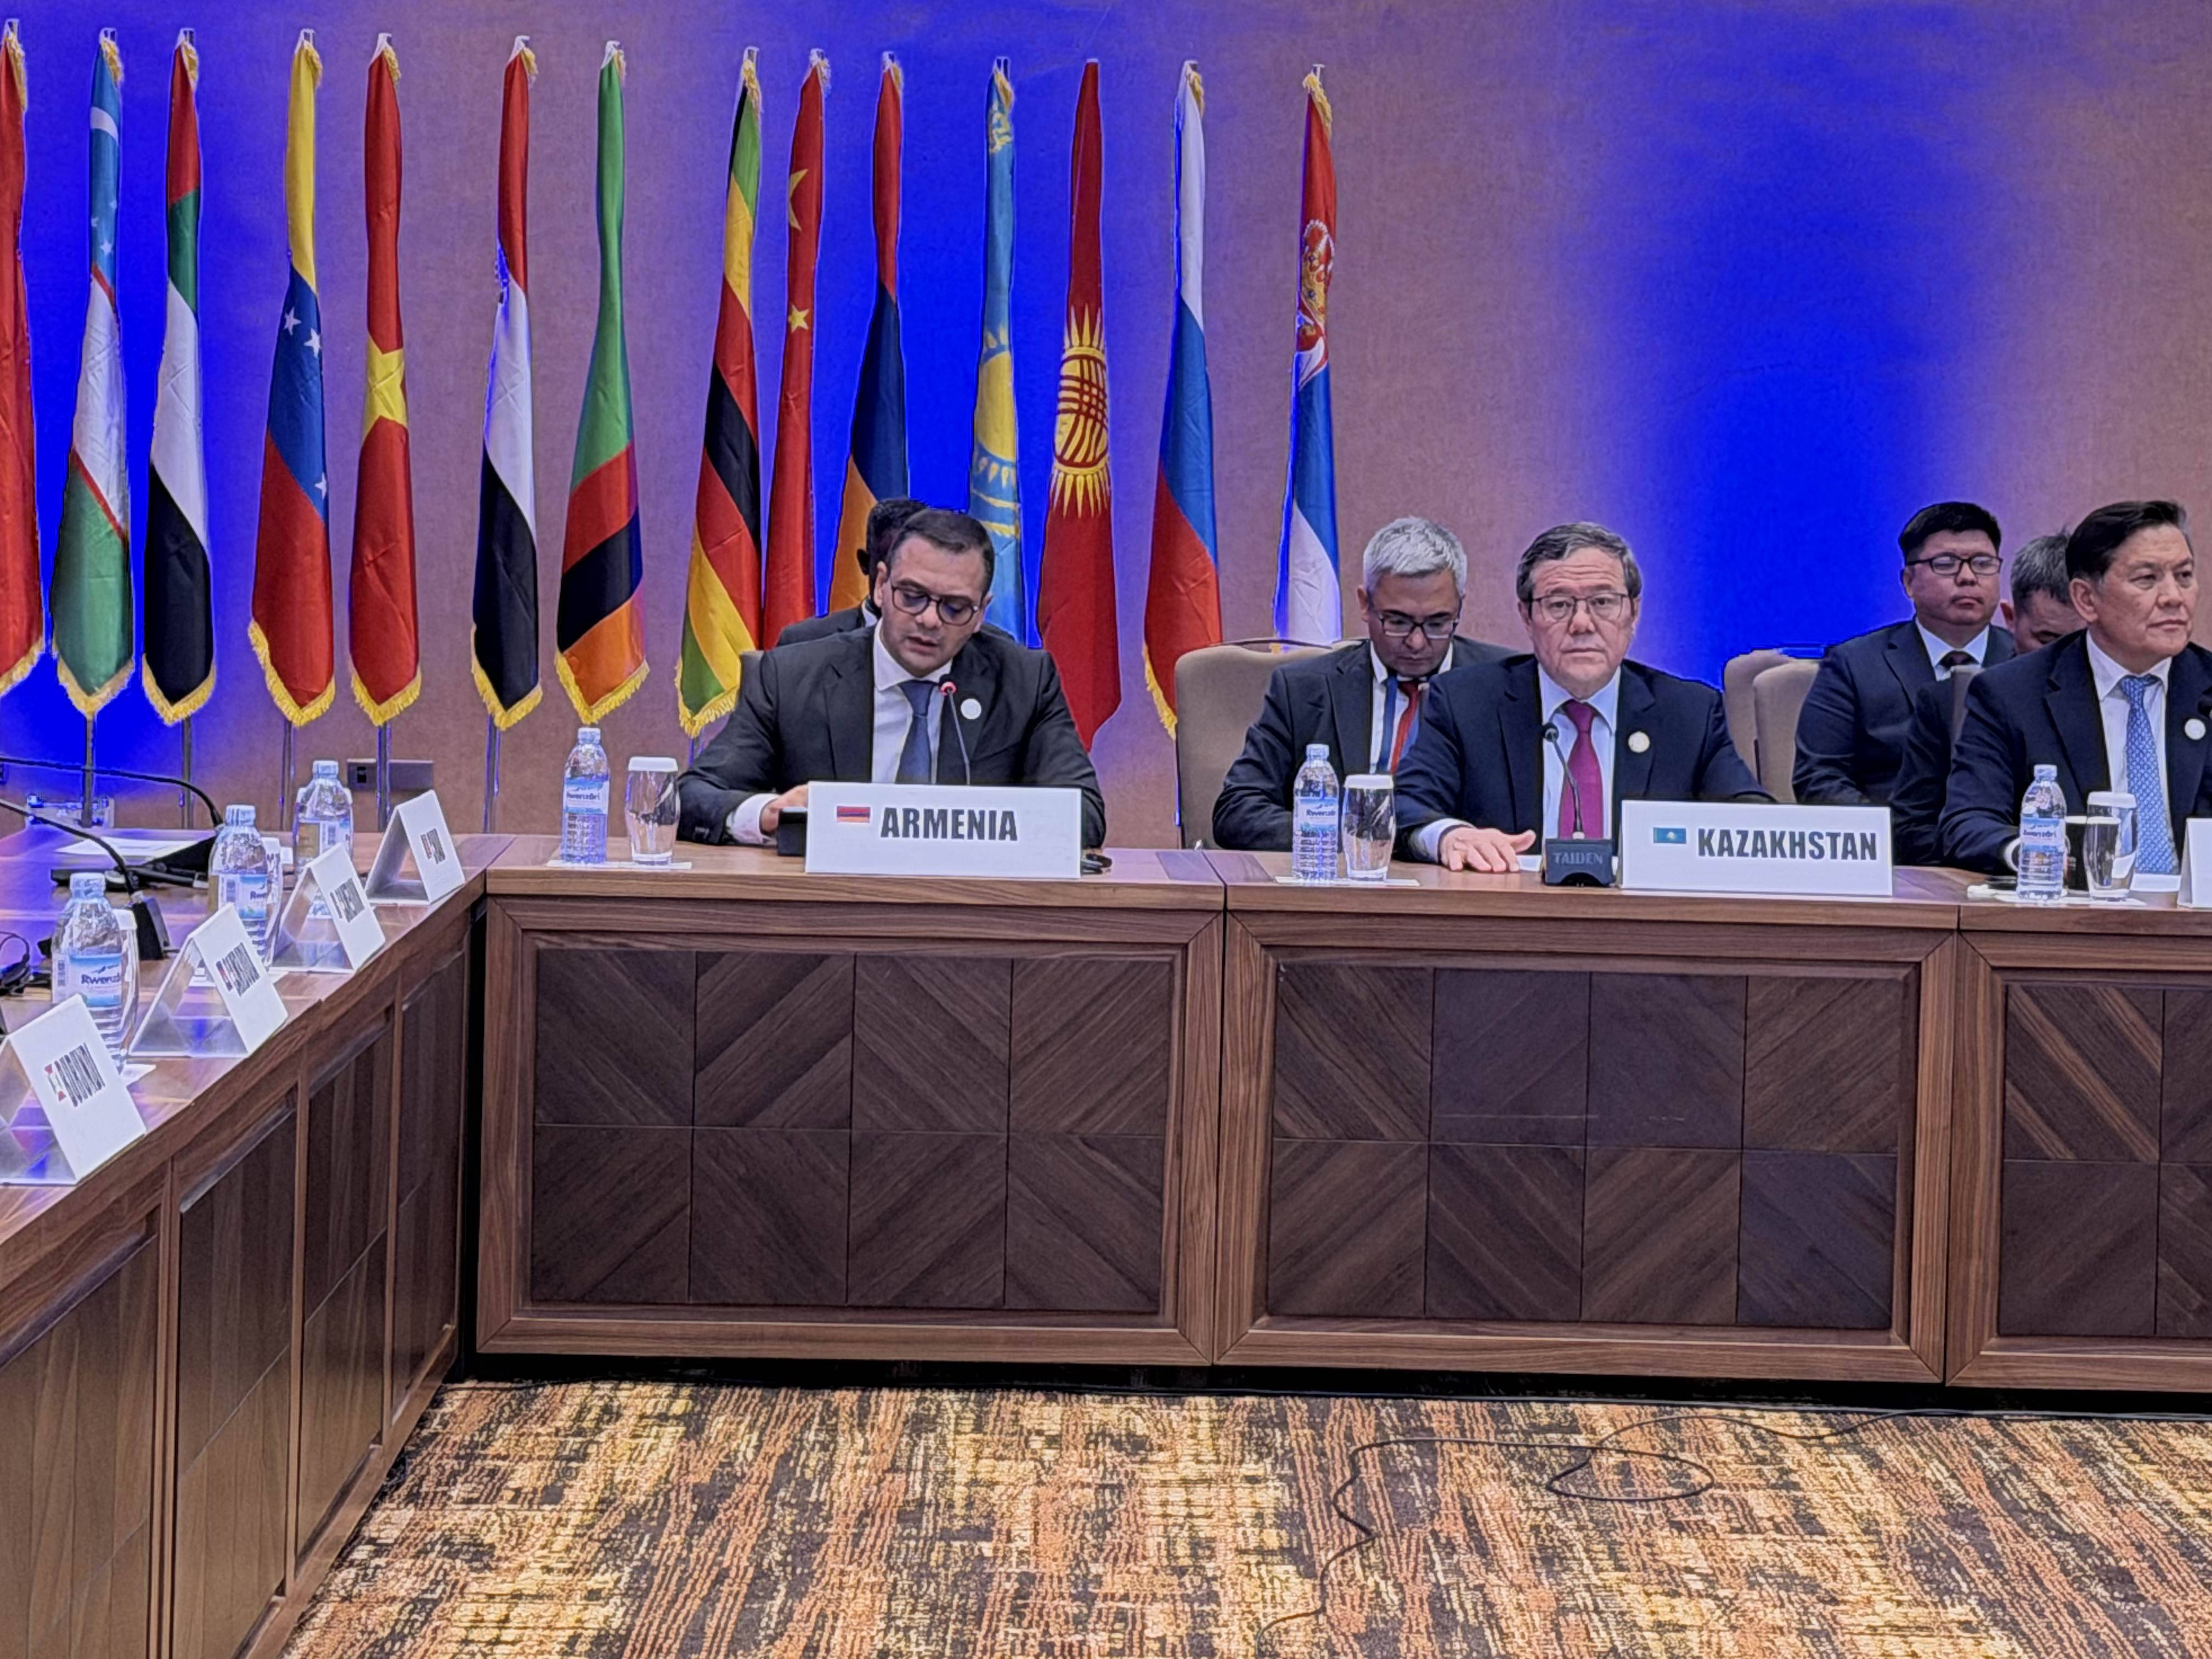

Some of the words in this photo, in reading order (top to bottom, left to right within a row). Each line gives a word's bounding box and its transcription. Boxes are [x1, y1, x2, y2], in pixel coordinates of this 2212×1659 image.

[881, 808, 1017, 841] ARMENIA
[1554, 852, 1603, 864] TAIDEN
[1698, 828, 1877, 860] KAZAKHSTAN
